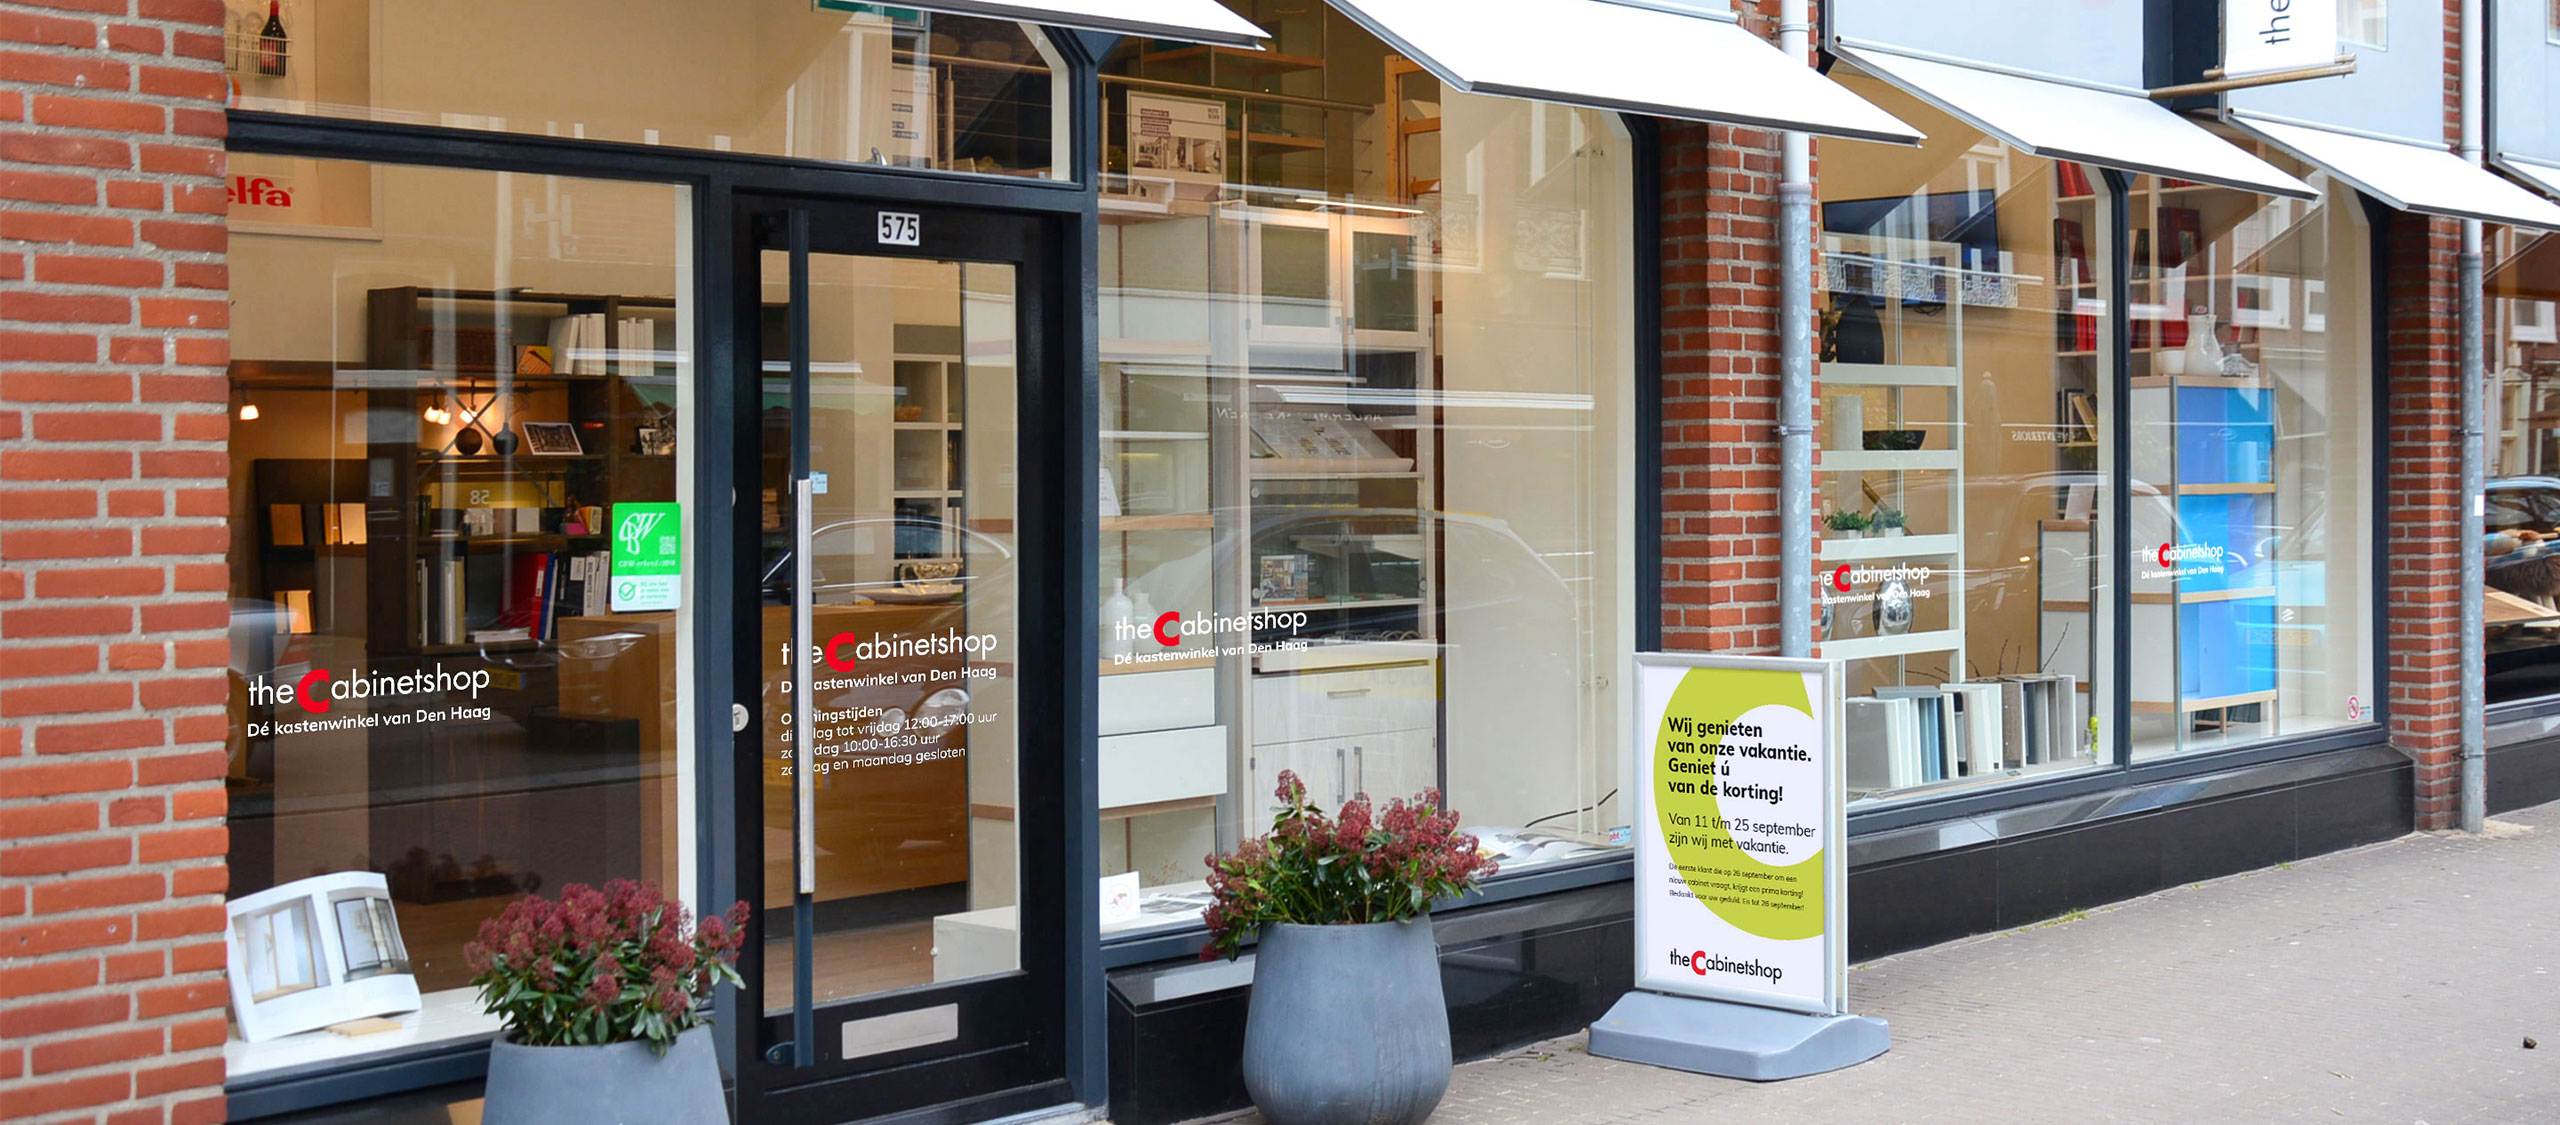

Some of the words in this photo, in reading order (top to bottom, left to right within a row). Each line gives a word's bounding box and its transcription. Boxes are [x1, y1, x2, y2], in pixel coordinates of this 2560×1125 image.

[882, 214, 917, 241] 575
[1910, 589, 1931, 599] Haag
[1114, 606, 1307, 646] theCabinetshop
[1114, 652, 1132, 666] Dé
[1135, 646, 1219, 664] kastenwinkel
[1221, 646, 1245, 657] van
[1248, 643, 1273, 654] Den
[1275, 640, 1308, 652] Haag
[248, 662, 490, 714] theCabinetshop
[813, 672, 898, 691] astenwinkel
[901, 673, 926, 684] van
[930, 669, 957, 681] Den
[960, 667, 997, 680] Haag
[247, 720, 270, 737] Dé
[274, 713, 379, 735] kastenwinkel
[382, 712, 411, 726] van
[416, 709, 446, 723] Den
[450, 706, 491, 721] Haag
[836, 725, 854, 737] tot
[857, 721, 900, 736] vrijdag
[904, 713, 975, 731] 12:00-17:00
[978, 714, 998, 724] uur
[1668, 716, 1692, 738] Wij
[1697, 719, 1763, 739] genieten
[843, 735, 917, 753] 10:00-16:30
[920, 735, 940, 745] uur
[1668, 740, 1695, 754] van
[1700, 743, 1735, 757] onze
[1739, 742, 1812, 762] vakantie.
[833, 761, 849, 771] en
[852, 753, 912, 769] maandag
[916, 747, 966, 764] gesloten
[1668, 757, 1716, 775] Geniet
[1721, 760, 1730, 776] ú
[1668, 781, 1695, 795] van
[1700, 779, 1718, 796] de
[1723, 780, 1783, 805] korting!
[1668, 812, 1691, 827] Van
[1695, 814, 1708, 828] 11
[1712, 816, 1731, 830] t/m
[1734, 818, 1750, 832] 25
[1752, 821, 1816, 838] september
[1668, 831, 1688, 848] zijn
[1691, 834, 1708, 850] wij
[1711, 836, 1733, 849] met
[1736, 838, 1789, 855] vakantie.
[1697, 865, 1713, 874] klant
[1713, 866, 1722, 875] die
[1723, 869, 1732, 877] op
[1732, 869, 1741, 877] 26
[1741, 871, 1774, 880] september
[1688, 878, 1709, 888] cabinet
[1732, 882, 1748, 893] krijgt
[1761, 886, 1780, 895] prima
[1780, 887, 1804, 900] korting!
[1669, 947, 1782, 985] theCabinetshop
